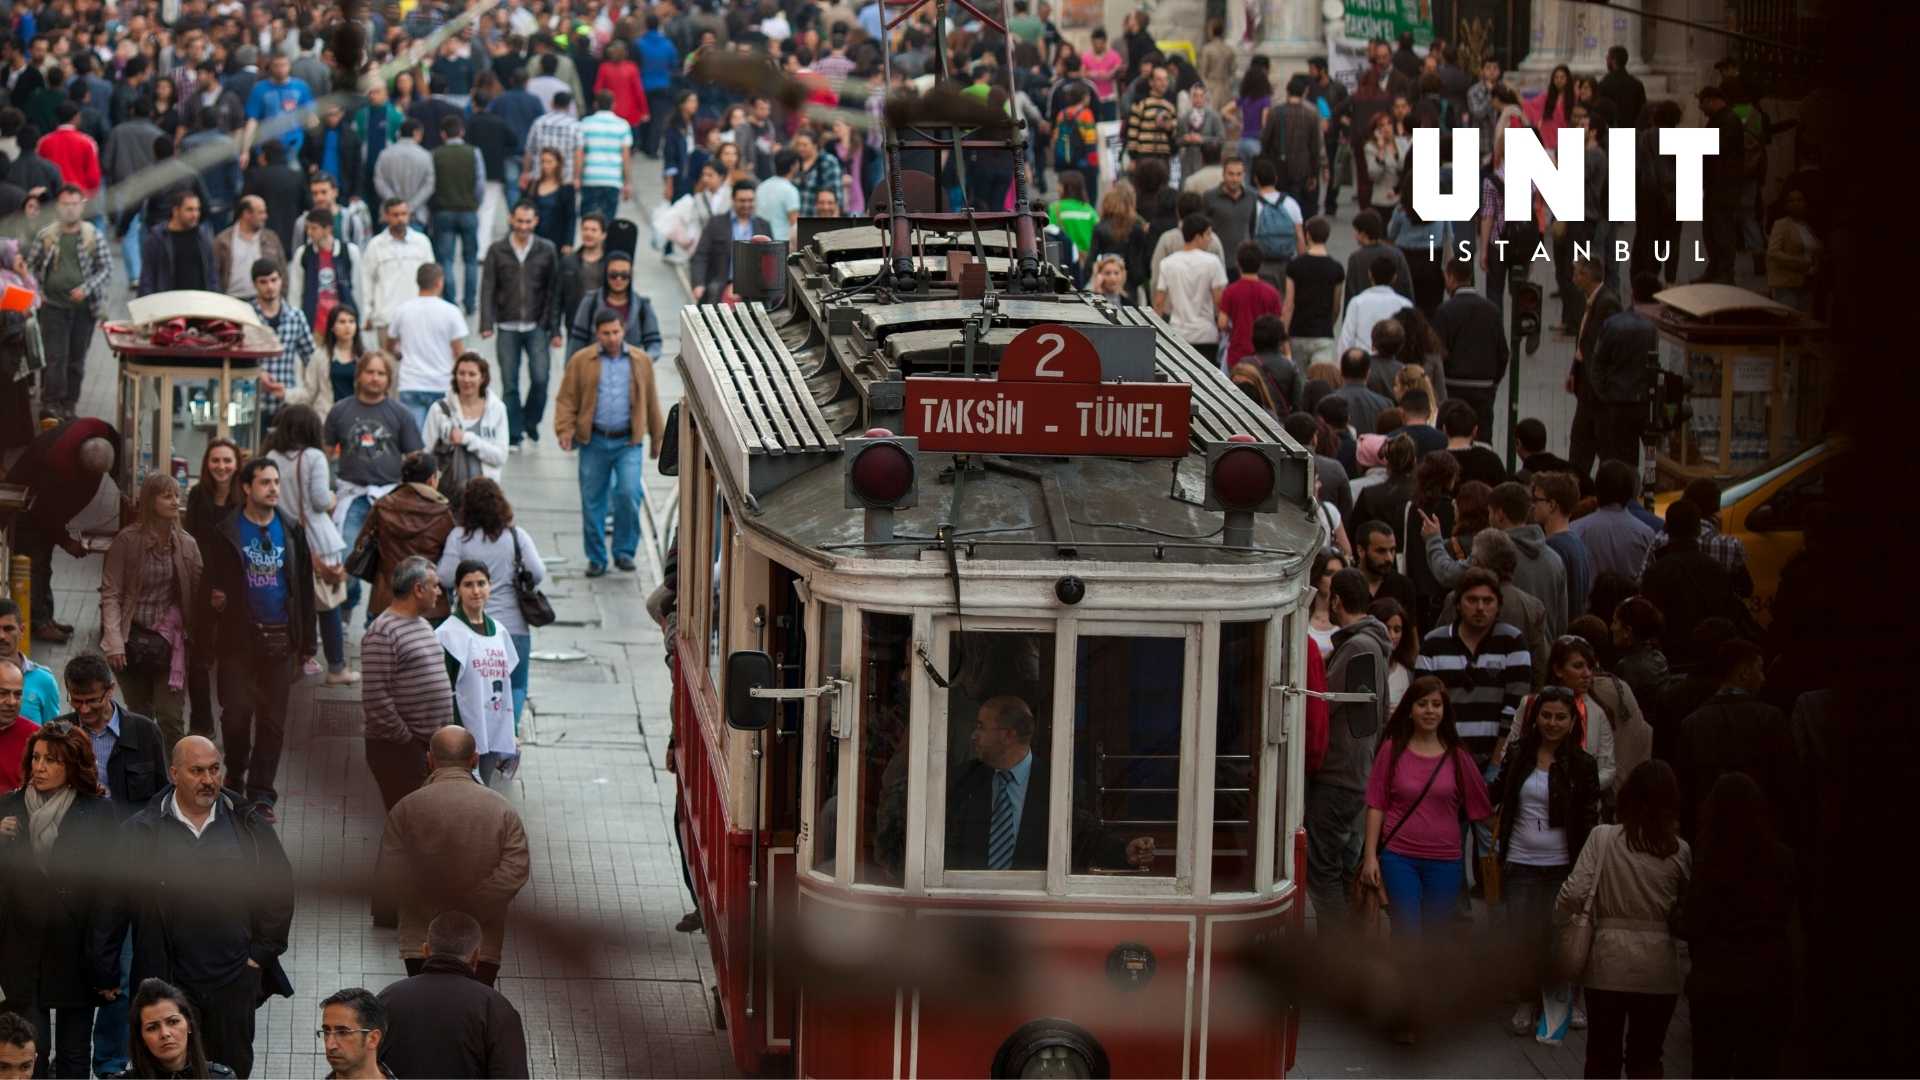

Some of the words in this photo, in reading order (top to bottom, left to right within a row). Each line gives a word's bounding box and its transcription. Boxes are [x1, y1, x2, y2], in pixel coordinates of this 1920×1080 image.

[1035, 333, 1065, 378] 2
[919, 393, 1024, 435] TAKSİM
[1076, 396, 1173, 438] TÜNEL
